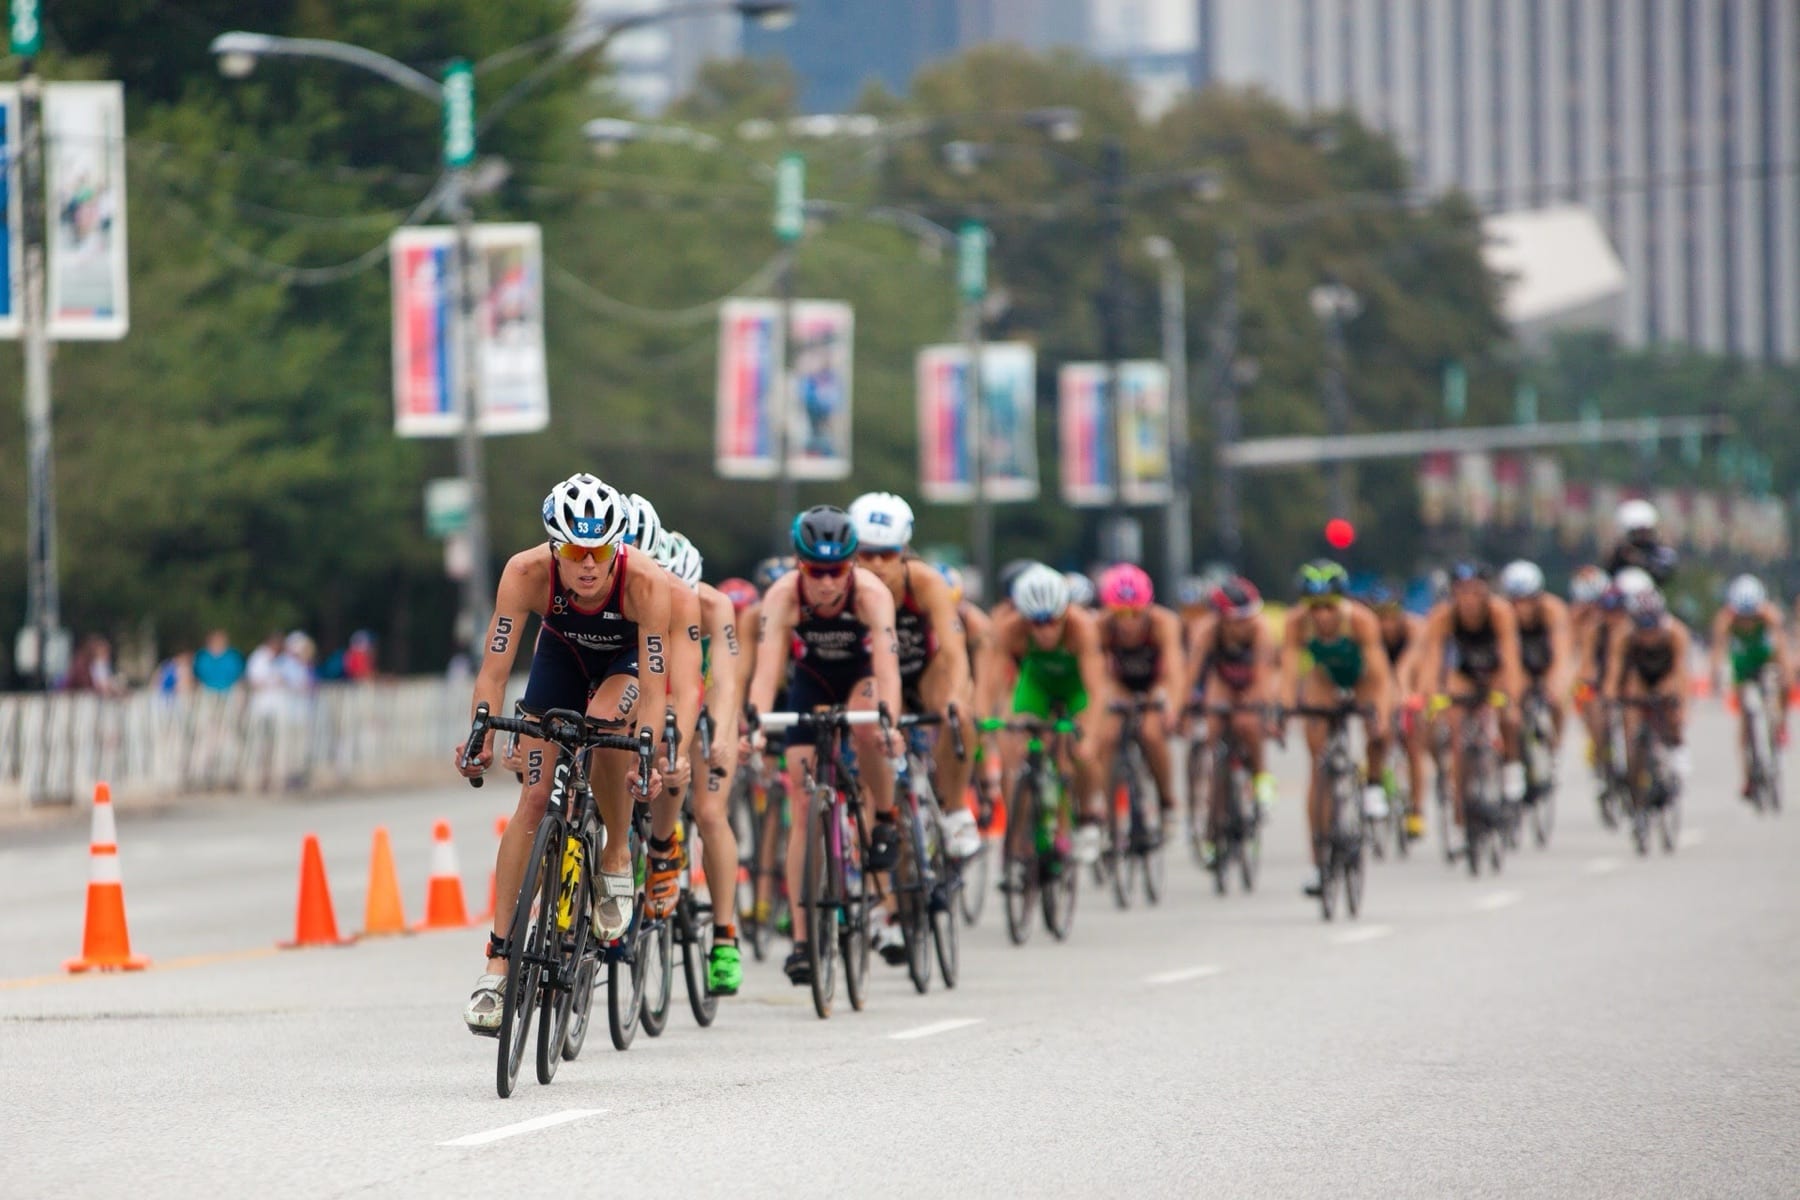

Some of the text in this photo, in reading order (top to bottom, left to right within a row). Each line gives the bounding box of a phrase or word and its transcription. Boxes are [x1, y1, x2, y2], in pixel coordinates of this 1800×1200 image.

[577, 521, 589, 534] 53
[490, 615, 513, 654] 53
[563, 631, 623, 642] JENKINS
[687, 624, 700, 641] 6
[645, 634, 666, 675] 53
[617, 683, 641, 716] 53
[527, 749, 543, 787] 53
